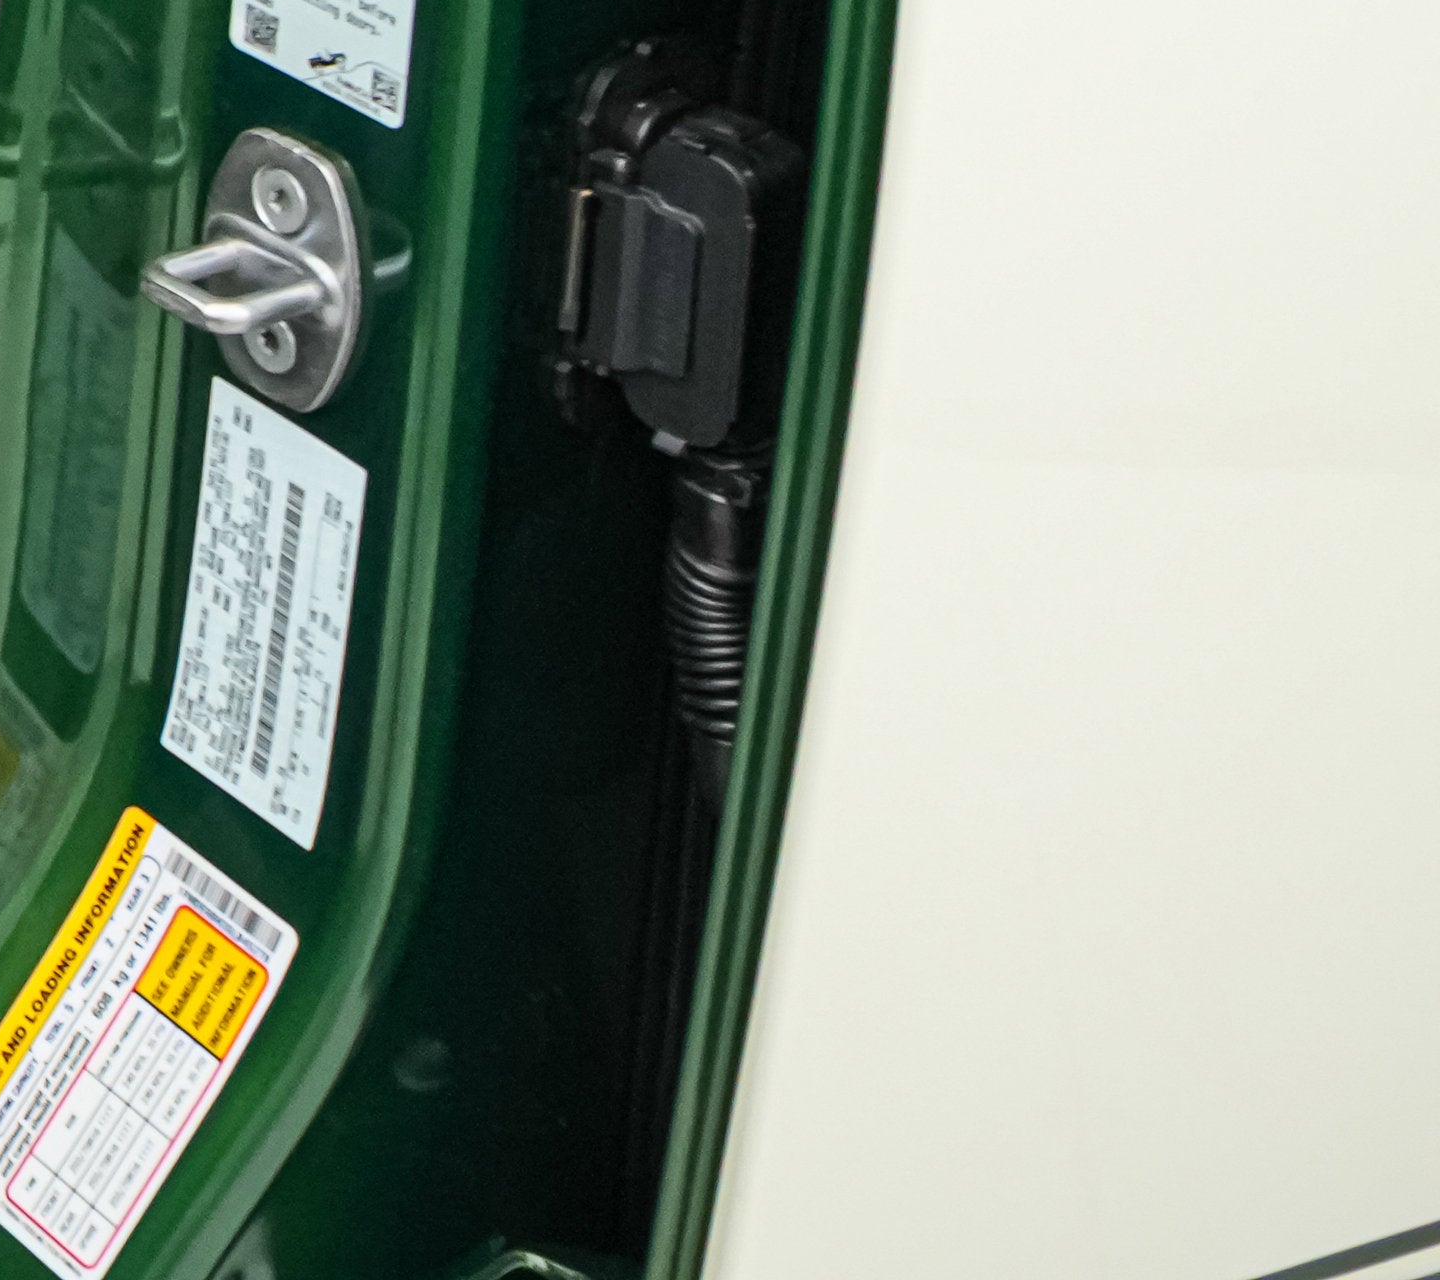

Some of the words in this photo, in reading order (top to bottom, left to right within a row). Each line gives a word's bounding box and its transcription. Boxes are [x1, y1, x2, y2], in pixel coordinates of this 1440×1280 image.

[0, 1023, 27, 1061] AND
[24, 945, 76, 1023] LOADING
[74, 823, 145, 943] INFORMATION
[92, 991, 112, 1019] 608
[112, 969, 128, 988] kg
[125, 953, 136, 967] or
[134, 917, 157, 948] 1341
